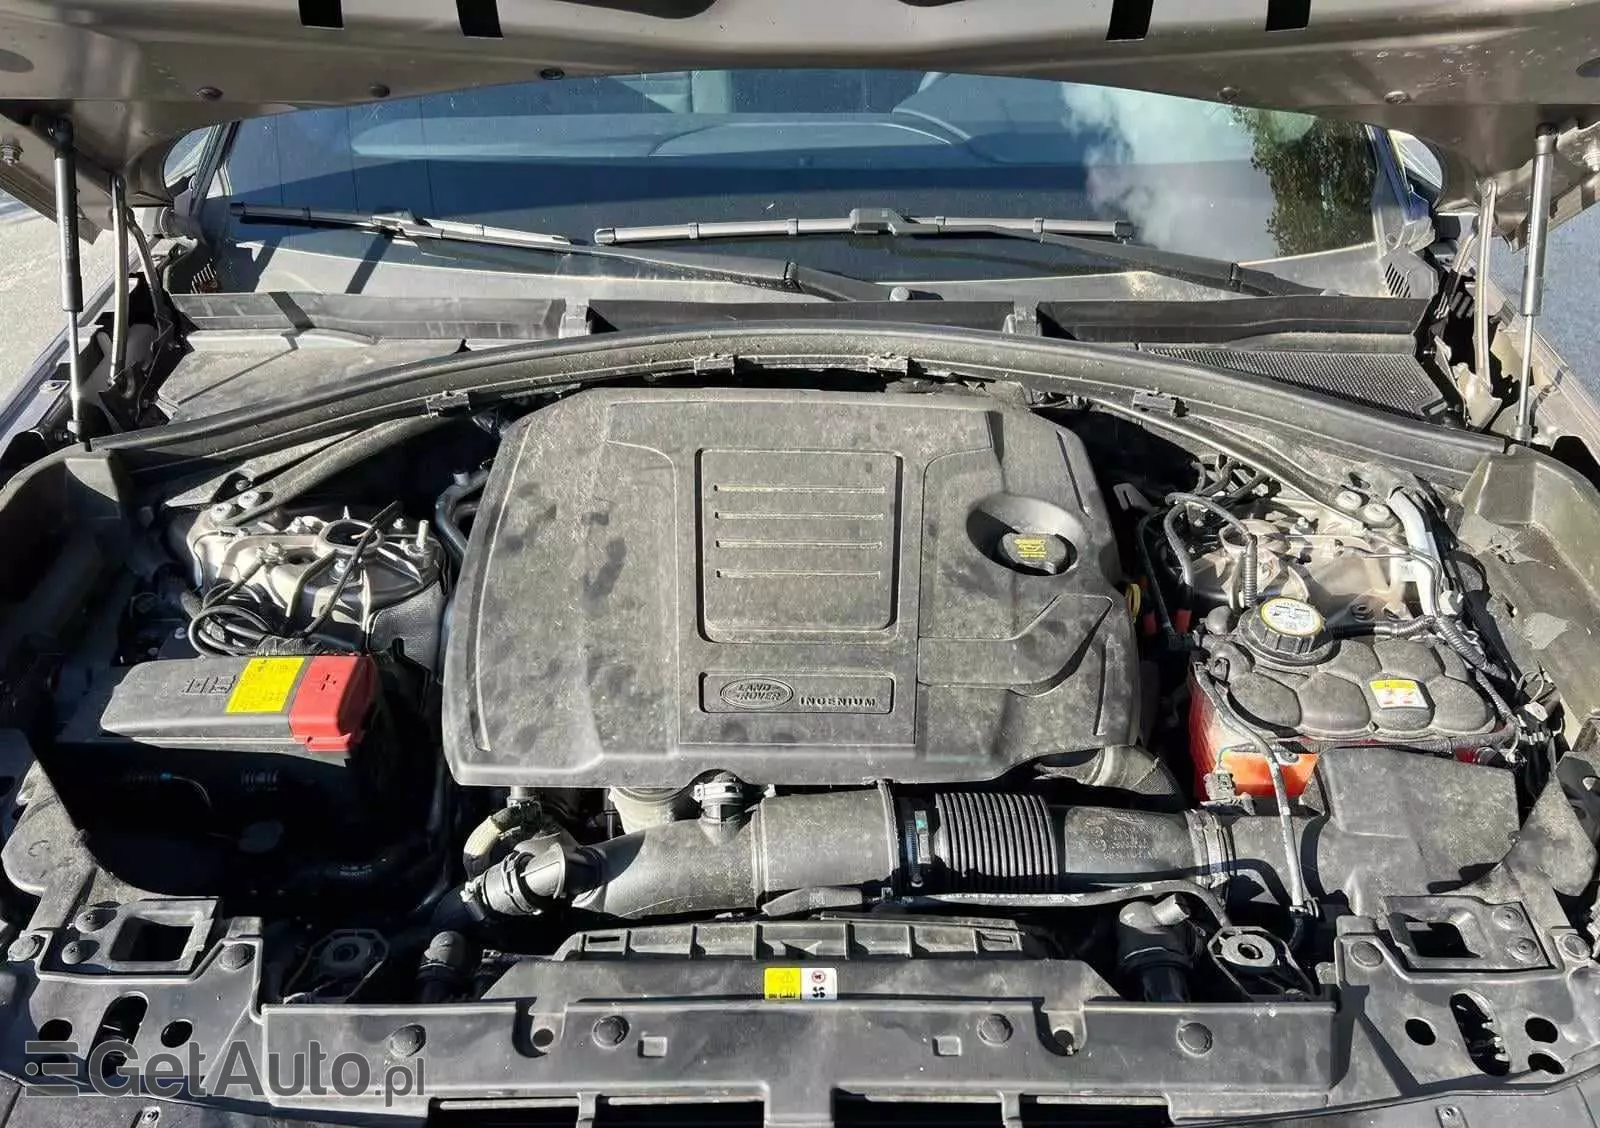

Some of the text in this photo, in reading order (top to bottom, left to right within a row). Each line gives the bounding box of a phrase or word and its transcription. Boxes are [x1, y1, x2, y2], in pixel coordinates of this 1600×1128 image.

[737, 683, 772, 692] LAND
[739, 691, 781, 701] ROVER
[800, 696, 876, 707] INGENIUM
